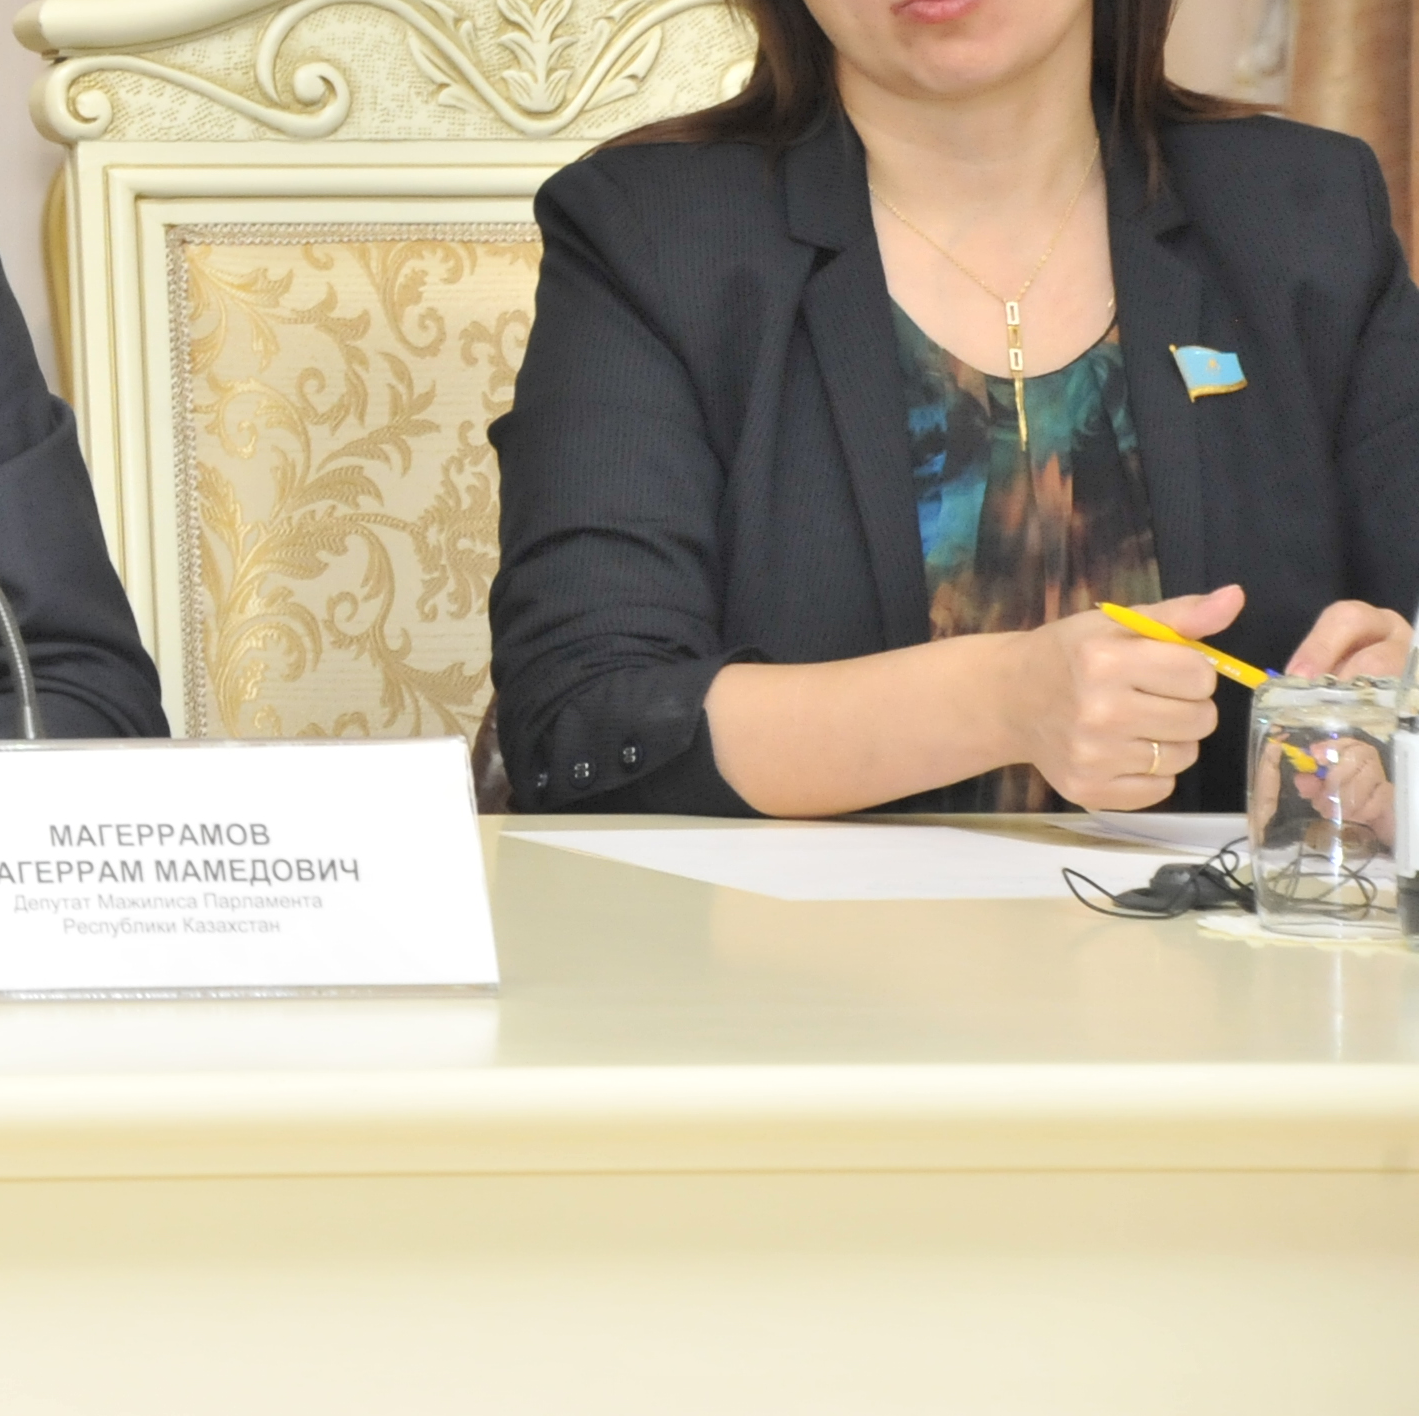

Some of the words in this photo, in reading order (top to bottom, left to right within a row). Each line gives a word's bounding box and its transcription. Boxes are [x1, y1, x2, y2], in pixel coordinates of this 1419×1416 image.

[49, 823, 271, 848] МАГЕРРАМОВ
[154, 857, 361, 886] МАМЕДОВИЧ
[13, 894, 91, 915] Депутат
[97, 893, 197, 911] Мажилиса
[203, 892, 323, 913] Парламента
[62, 917, 176, 936] Республики
[182, 917, 281, 933] Казахстан
